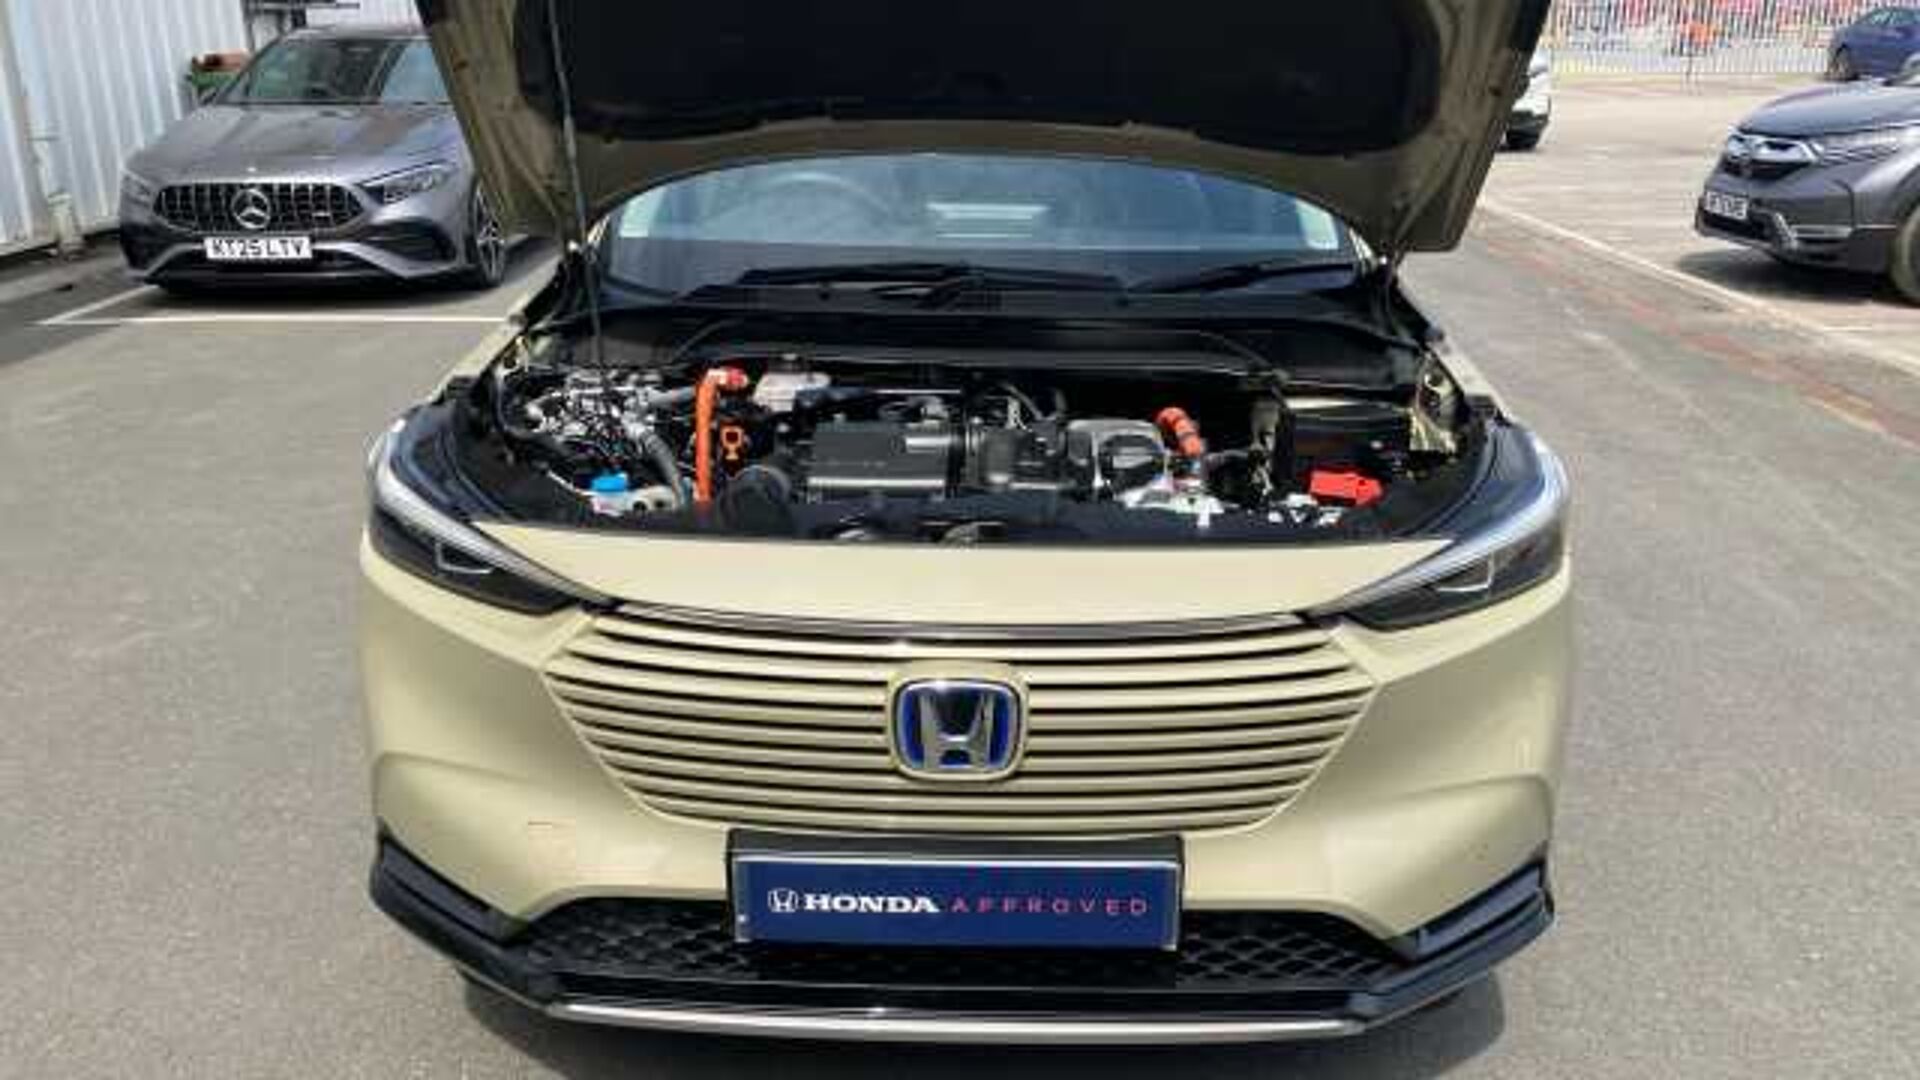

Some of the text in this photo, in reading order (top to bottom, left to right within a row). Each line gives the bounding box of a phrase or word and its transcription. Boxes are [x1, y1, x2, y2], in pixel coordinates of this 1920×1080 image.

[266, 239, 304, 256] LTV
[804, 893, 939, 913] HONDA
[952, 897, 1147, 915] APPROVED
